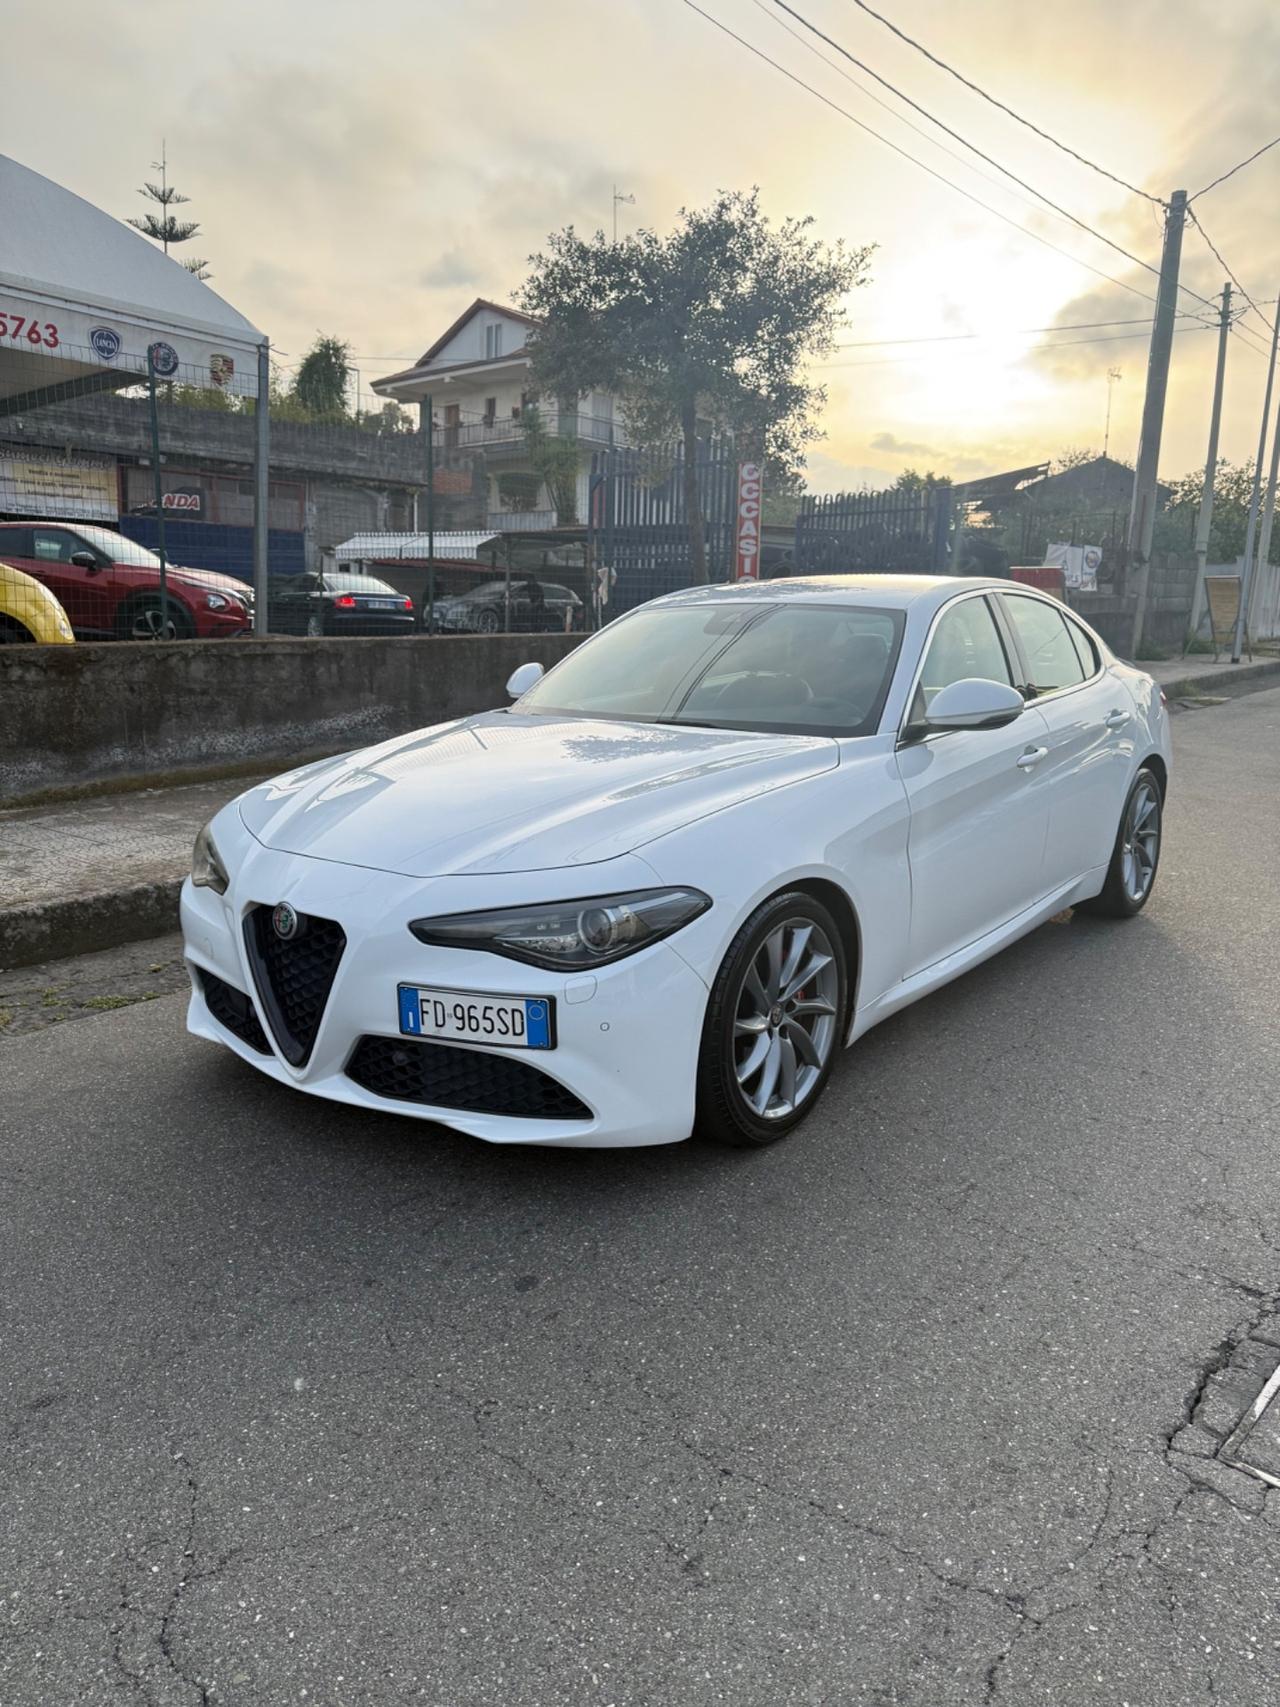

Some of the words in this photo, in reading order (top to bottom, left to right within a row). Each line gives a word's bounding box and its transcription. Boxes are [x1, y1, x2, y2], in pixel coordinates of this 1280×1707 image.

[96, 338, 116, 350] LANCIA
[738, 463, 760, 583] OCCASI
[419, 998, 446, 1028] FD
[453, 1003, 525, 1037] 965SD
